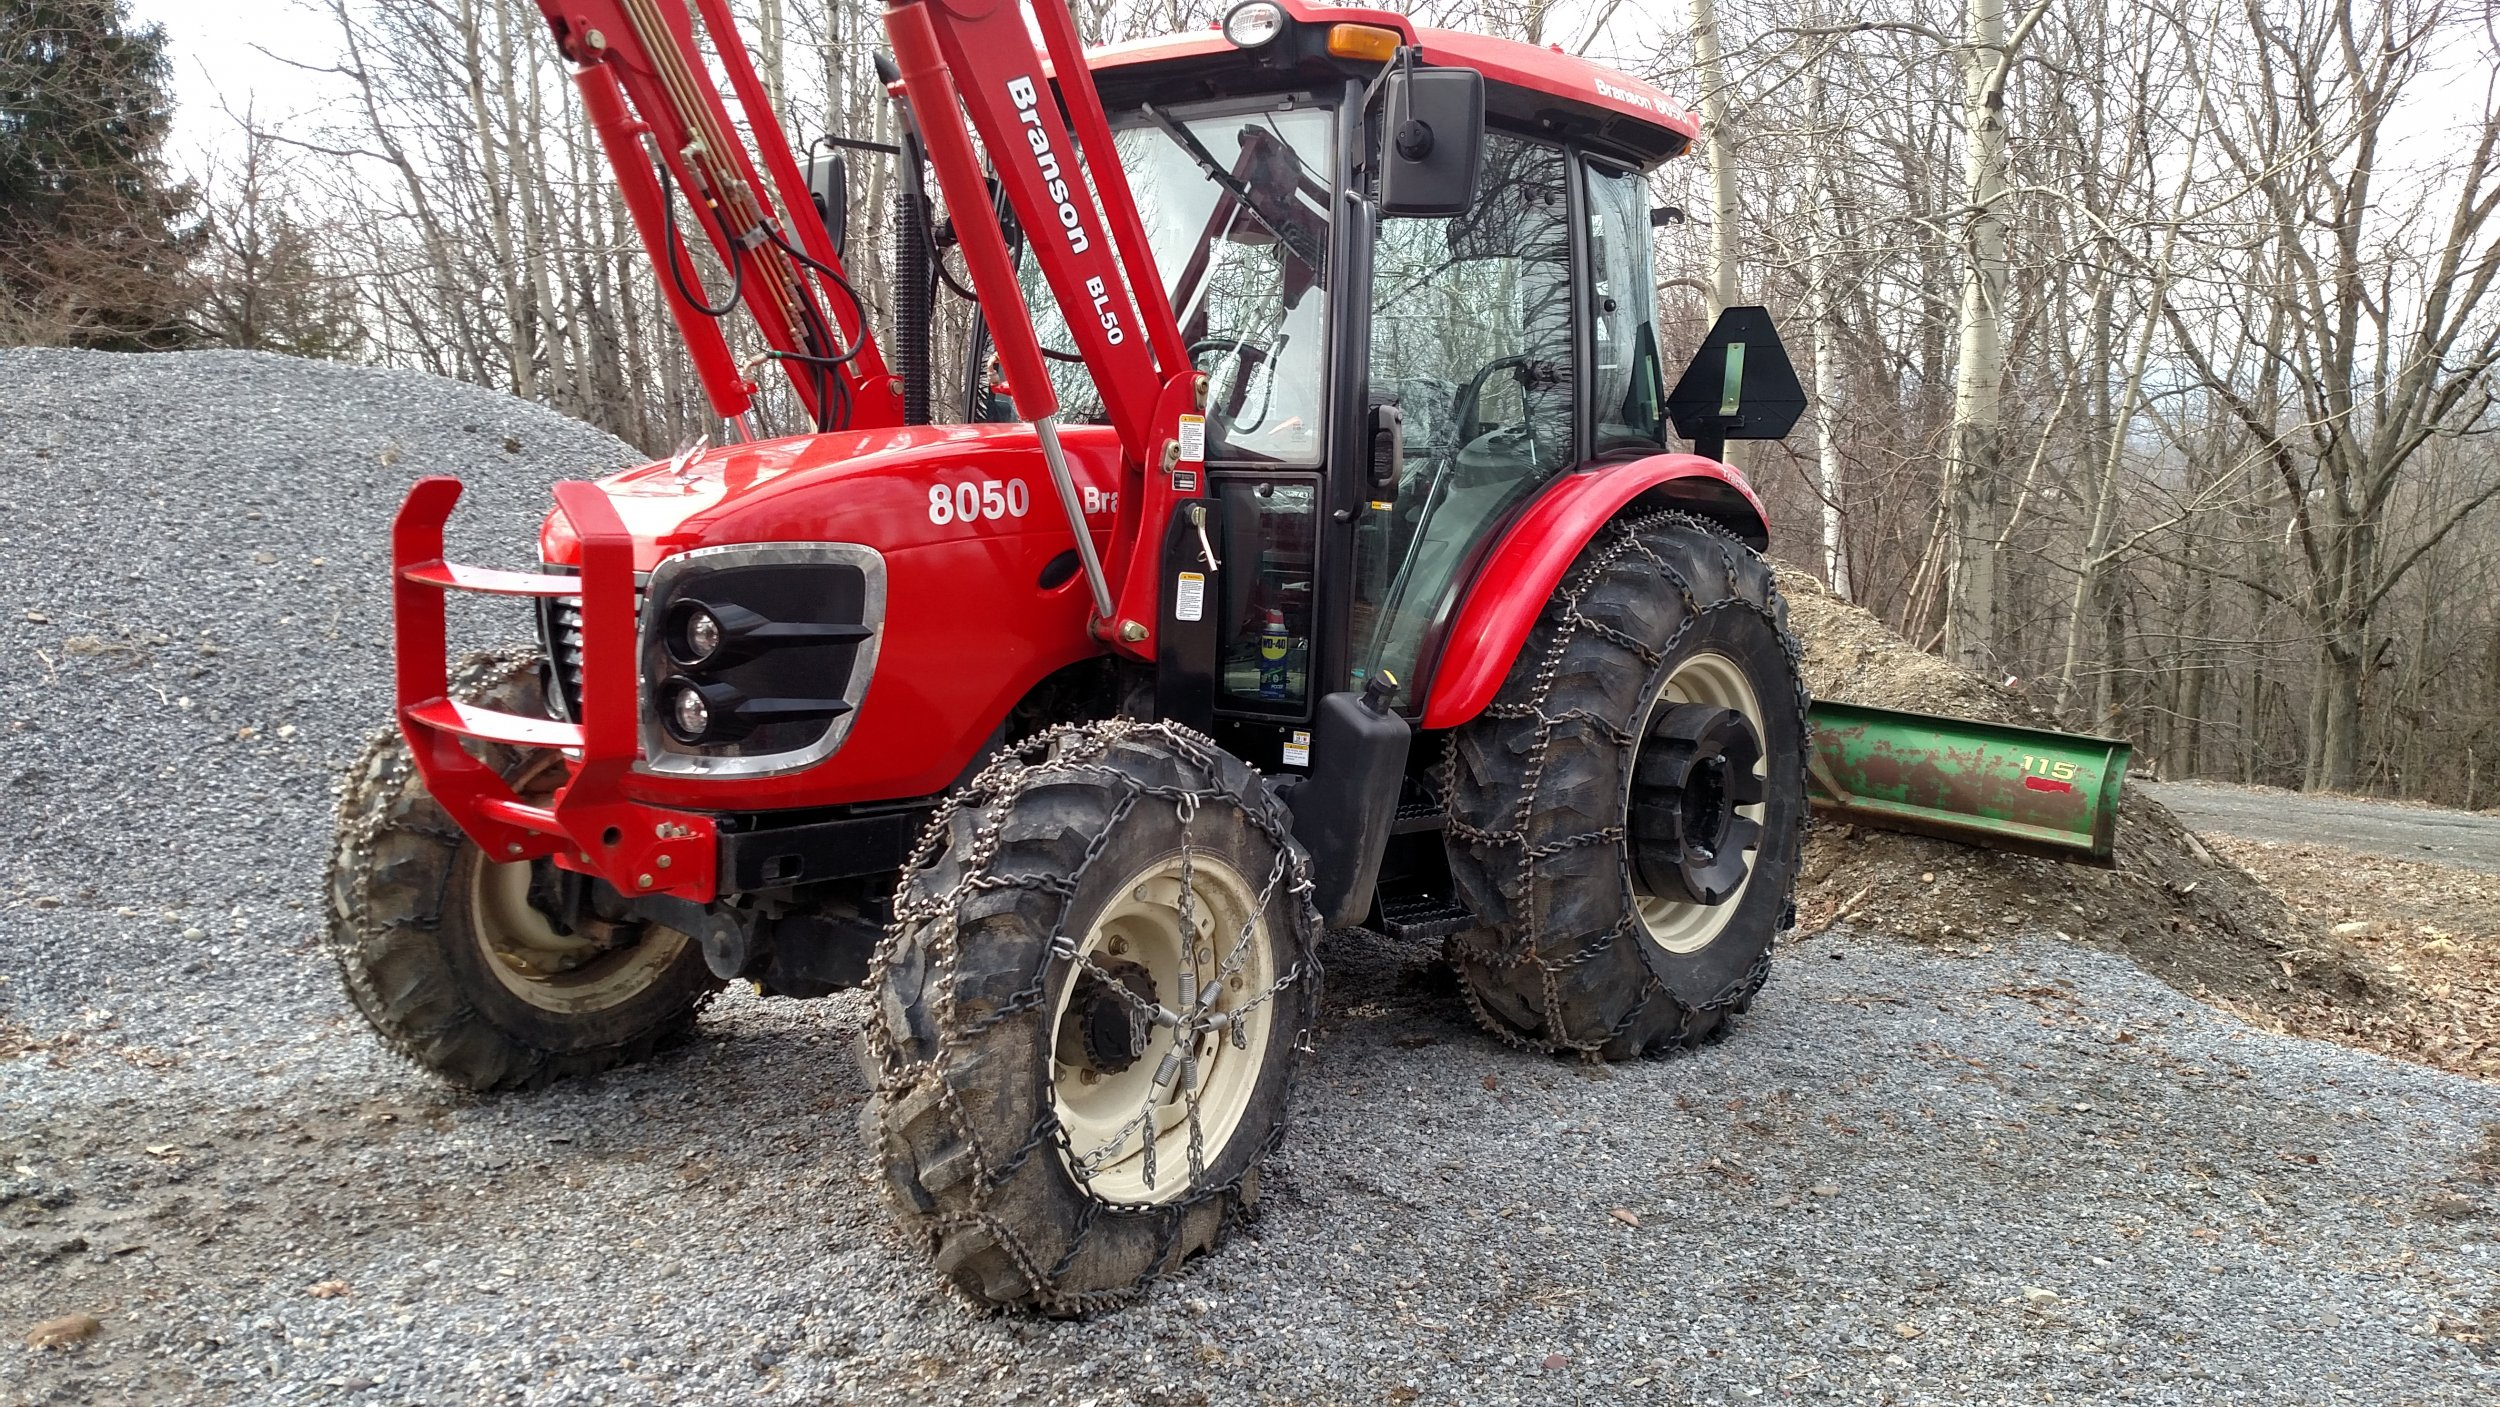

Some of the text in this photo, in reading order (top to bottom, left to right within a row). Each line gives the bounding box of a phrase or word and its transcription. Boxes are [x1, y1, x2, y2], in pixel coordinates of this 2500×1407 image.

[1594, 78, 1653, 111] Branson
[1005, 74, 1125, 345] Branson BL50
[928, 478, 1030, 526] 8050
[2023, 755, 2076, 780] 115
